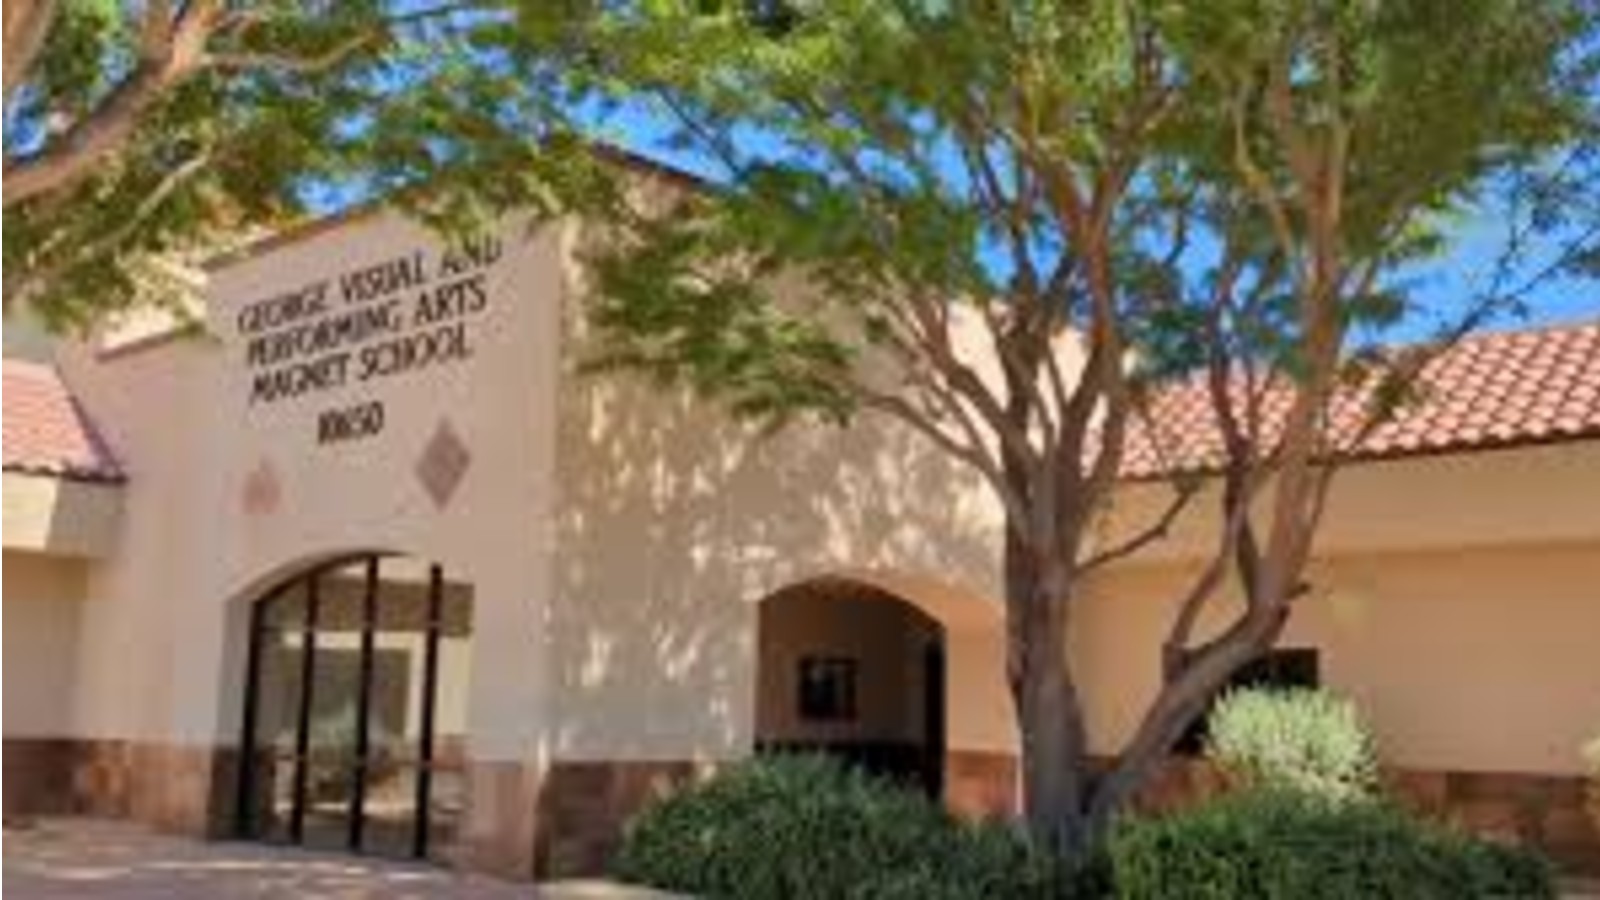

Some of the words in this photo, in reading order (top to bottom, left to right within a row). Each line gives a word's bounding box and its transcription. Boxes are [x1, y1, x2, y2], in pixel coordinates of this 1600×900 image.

[340, 249, 430, 303] VISUAL
[413, 272, 487, 327] ARTS
[358, 320, 474, 381] SCHOOL
